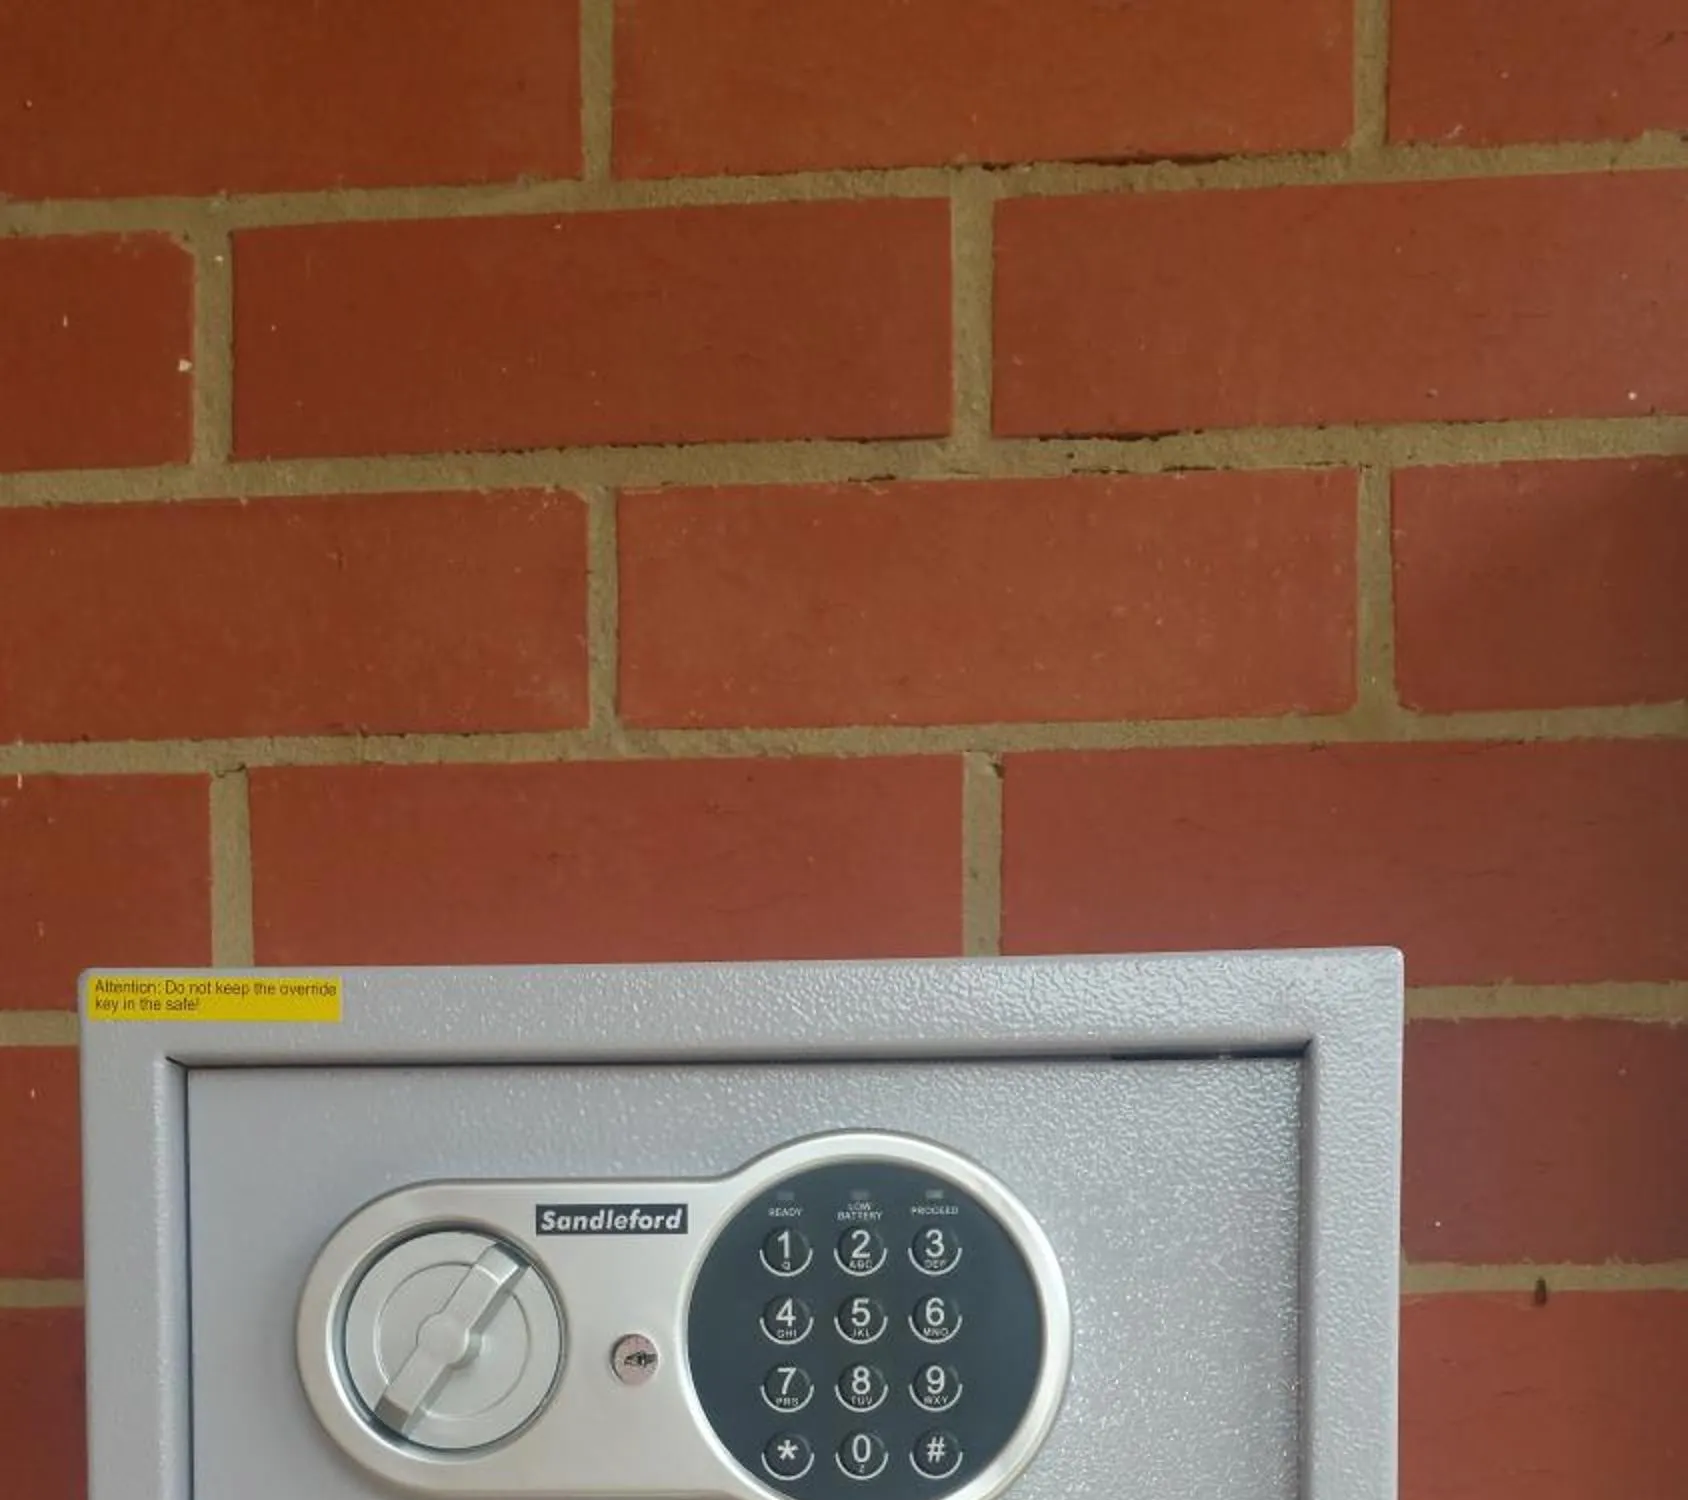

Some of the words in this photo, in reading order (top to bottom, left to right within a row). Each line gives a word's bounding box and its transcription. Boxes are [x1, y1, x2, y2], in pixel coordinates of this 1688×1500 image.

[95, 979, 161, 995] Attention:
[165, 979, 185, 995] Do
[189, 981, 211, 996] not
[215, 981, 249, 999] keep
[254, 981, 276, 997] the
[279, 981, 337, 998] override
[95, 997, 118, 1014] key
[123, 998, 135, 1013] in
[140, 998, 161, 1013] the
[165, 997, 200, 1013] safe!
[541, 1208, 683, 1231] Sandleford
[768, 1207, 802, 1217] READY
[836, 1211, 883, 1220] BATTERY
[847, 1203, 871, 1212] LOW
[911, 1205, 959, 1215] PROCEED
[777, 1230, 792, 1259] 1
[851, 1229, 871, 1259] 2
[924, 1228, 946, 1258] 3
[775, 1298, 797, 1327] 4
[851, 1298, 871, 1327] 5
[924, 1297, 946, 1327] 6
[777, 1367, 797, 1396] 7
[851, 1365, 871, 1395] 8
[926, 1365, 946, 1395] 9
